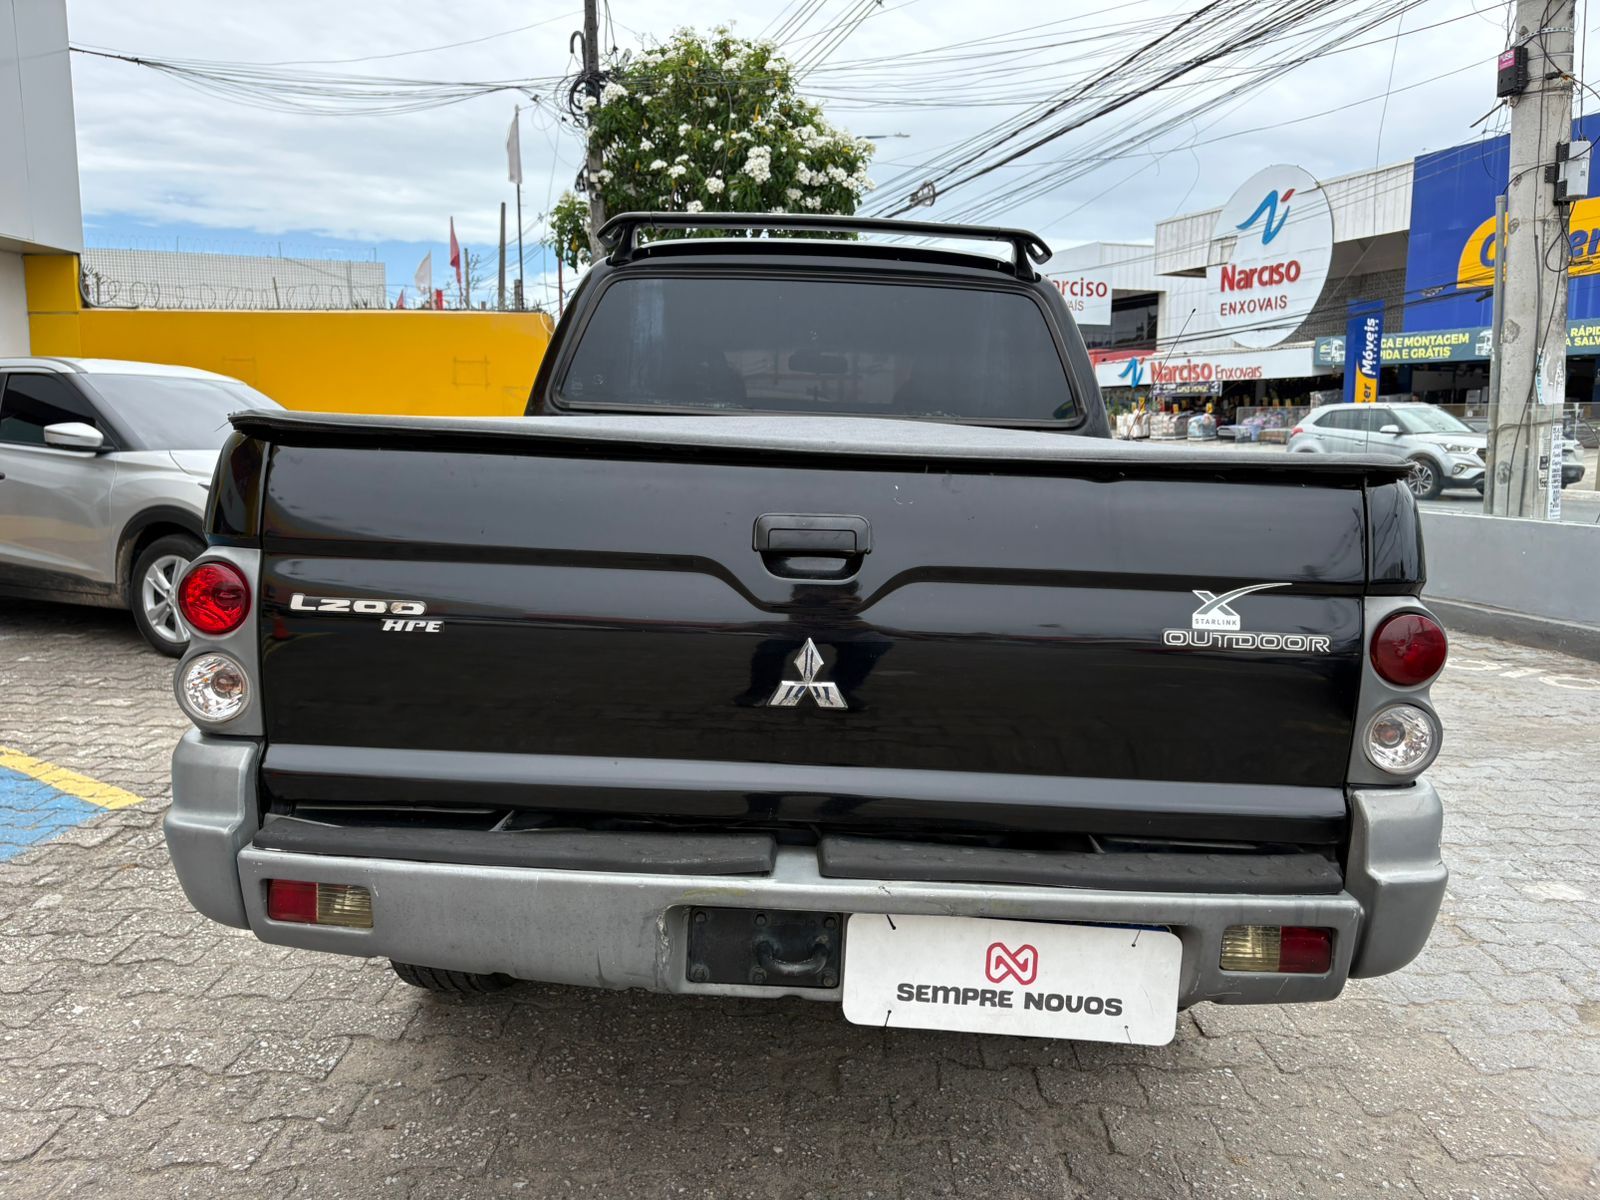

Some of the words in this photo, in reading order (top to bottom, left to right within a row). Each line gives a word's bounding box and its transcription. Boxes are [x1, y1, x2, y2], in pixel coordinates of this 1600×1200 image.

[1220, 260, 1301, 292] Narciso
[1220, 295, 1288, 316] ENXOVAIS
[1361, 318, 1376, 375] Móveis
[1404, 333, 1469, 347] MONTAGEM
[1410, 345, 1452, 359] GRÁTIS
[1150, 359, 1213, 384] Narciso
[1215, 364, 1263, 380] Enxovais
[290, 593, 426, 615] L200
[381, 620, 444, 633] HPE
[1194, 618, 1238, 627] STARLINK
[1163, 629, 1331, 653] OUTDOOR
[896, 983, 1014, 1009] SEMPRE
[1023, 991, 1123, 1017] NOVOS
